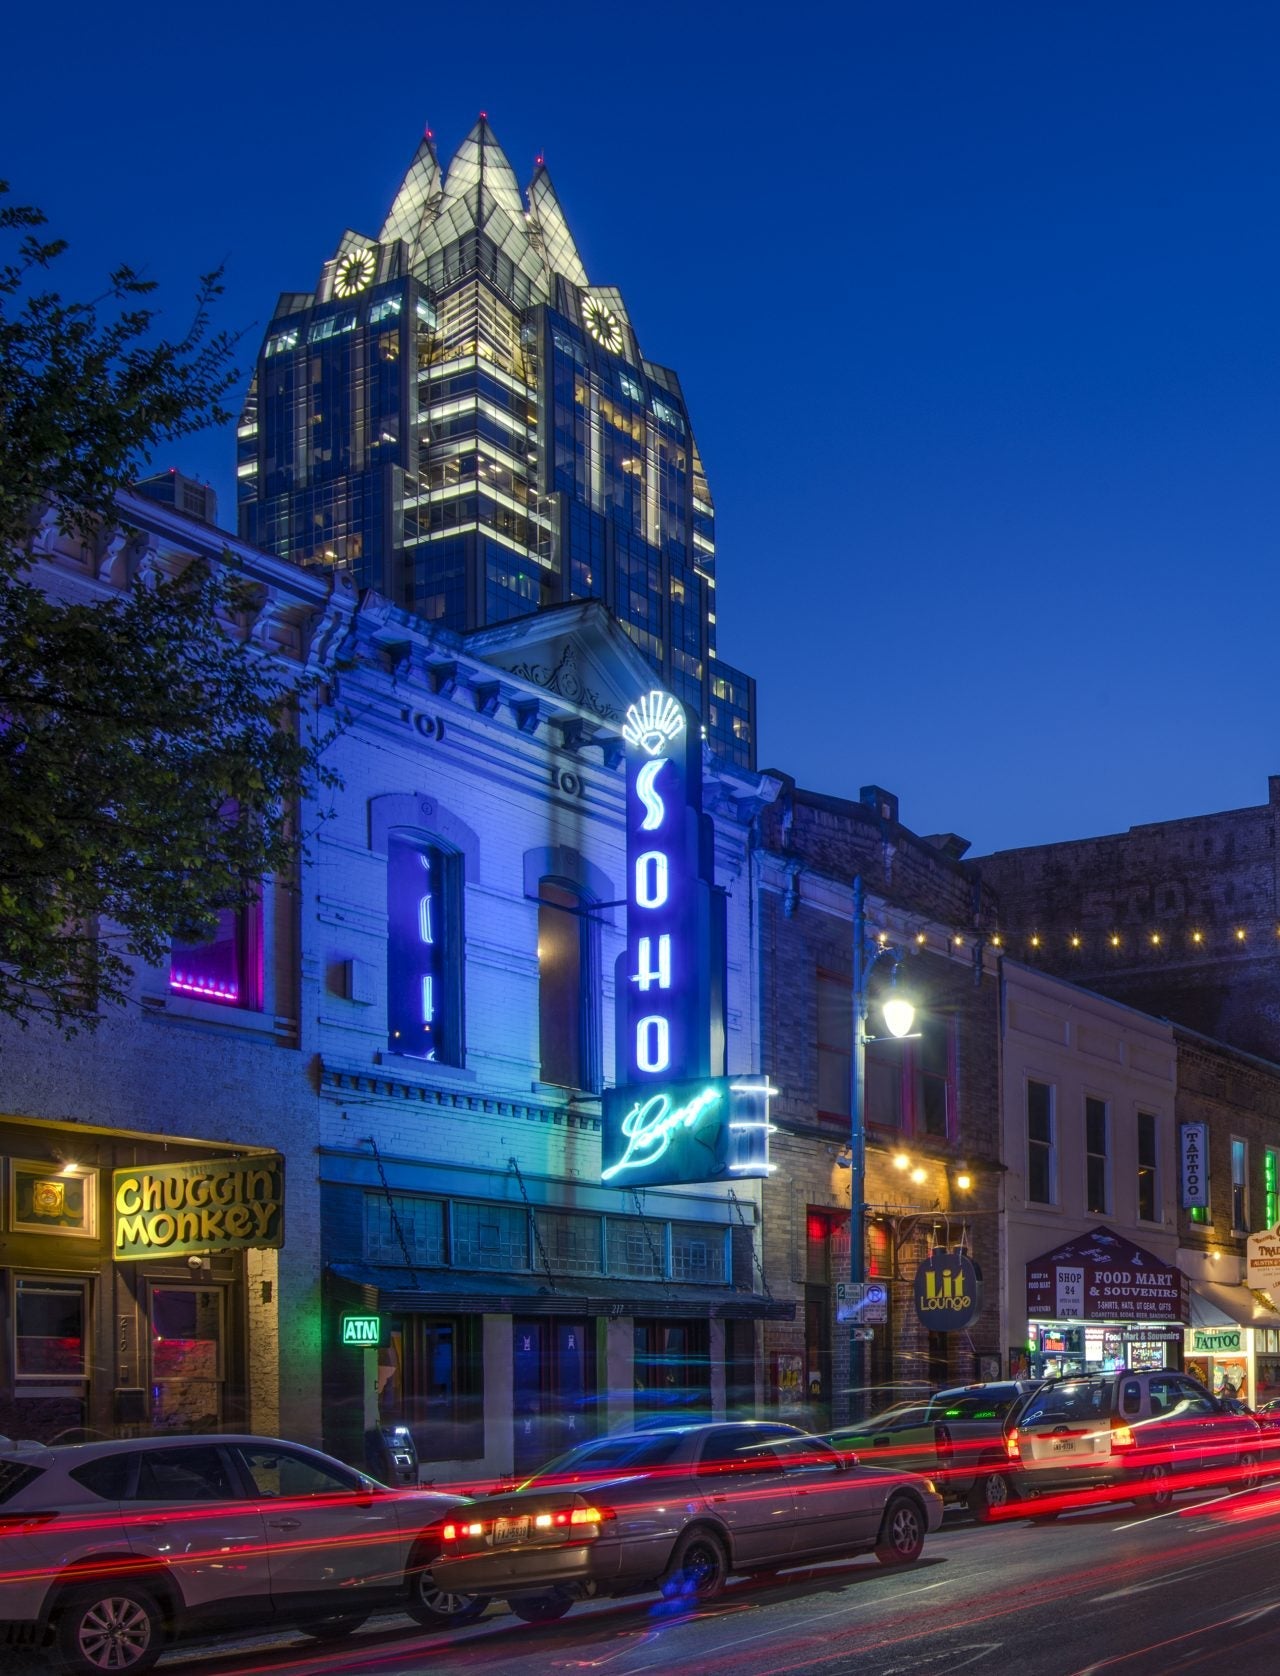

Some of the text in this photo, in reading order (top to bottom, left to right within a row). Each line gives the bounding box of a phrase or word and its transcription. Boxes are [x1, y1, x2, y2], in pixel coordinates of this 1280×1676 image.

[633, 757, 671, 1073] SOHO
[1186, 1132, 1199, 1196] TATTOO
[925, 1269, 965, 1299] Lit
[1058, 1272, 1082, 1283] SHOP
[1094, 1271, 1173, 1287] FOOD MART
[838, 1286, 845, 1297] 2
[1065, 1286, 1075, 1295] 24
[1089, 1286, 1178, 1298] & SOUVENIRS
[920, 1295, 971, 1311] Lounge
[345, 1320, 378, 1340] ATM
[1105, 1332, 1121, 1341] Food
[1123, 1332, 1139, 1341] Mart
[1141, 1332, 1146, 1340] &
[1147, 1331, 1180, 1341] Souvenirs
[1195, 1334, 1240, 1349] TATTOO
